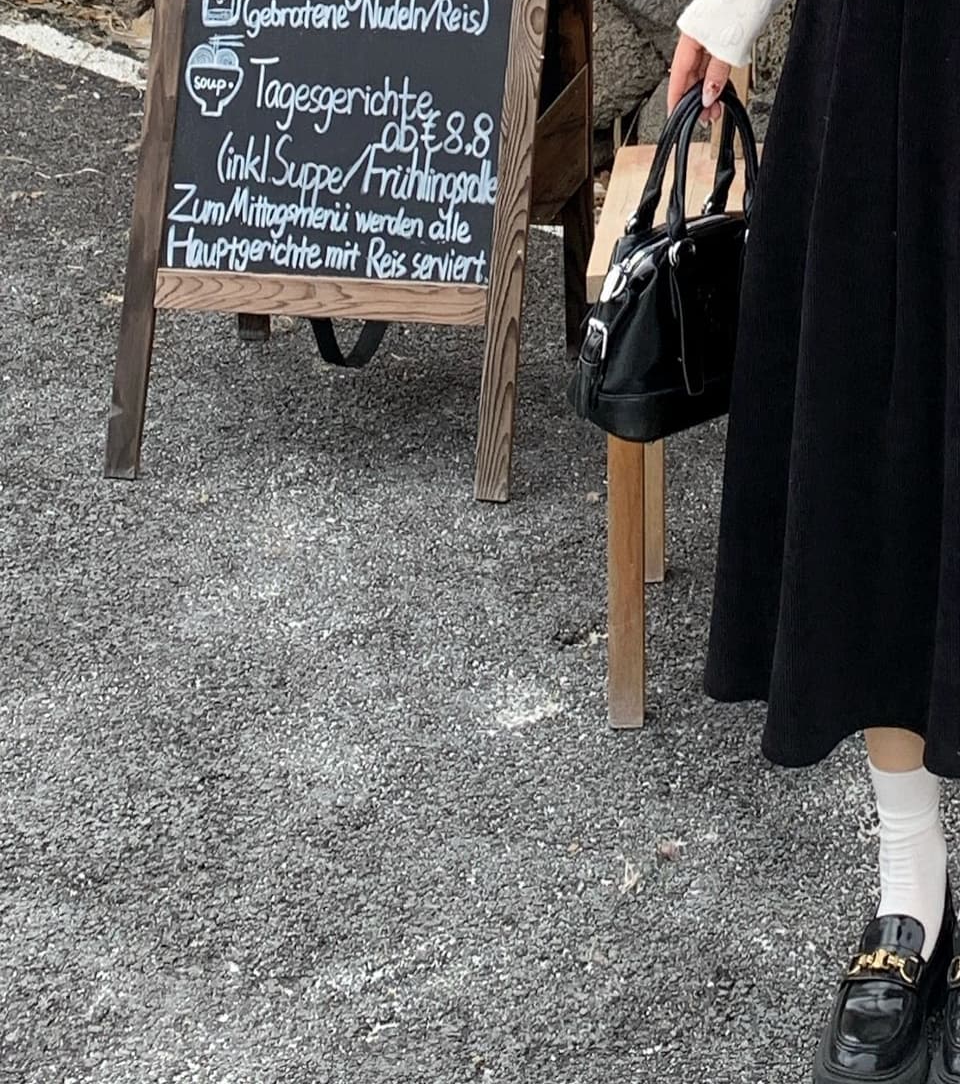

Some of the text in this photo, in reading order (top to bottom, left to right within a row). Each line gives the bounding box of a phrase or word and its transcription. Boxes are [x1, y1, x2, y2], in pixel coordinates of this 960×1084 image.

[250, 56, 433, 134] Tagesgerichte
[168, 183, 472, 243] Zum Mittagsmenü werden alle
[167, 225, 323, 272] Hauptgerichte
[325, 241, 361, 271] mit
[366, 236, 407, 279] Reis
